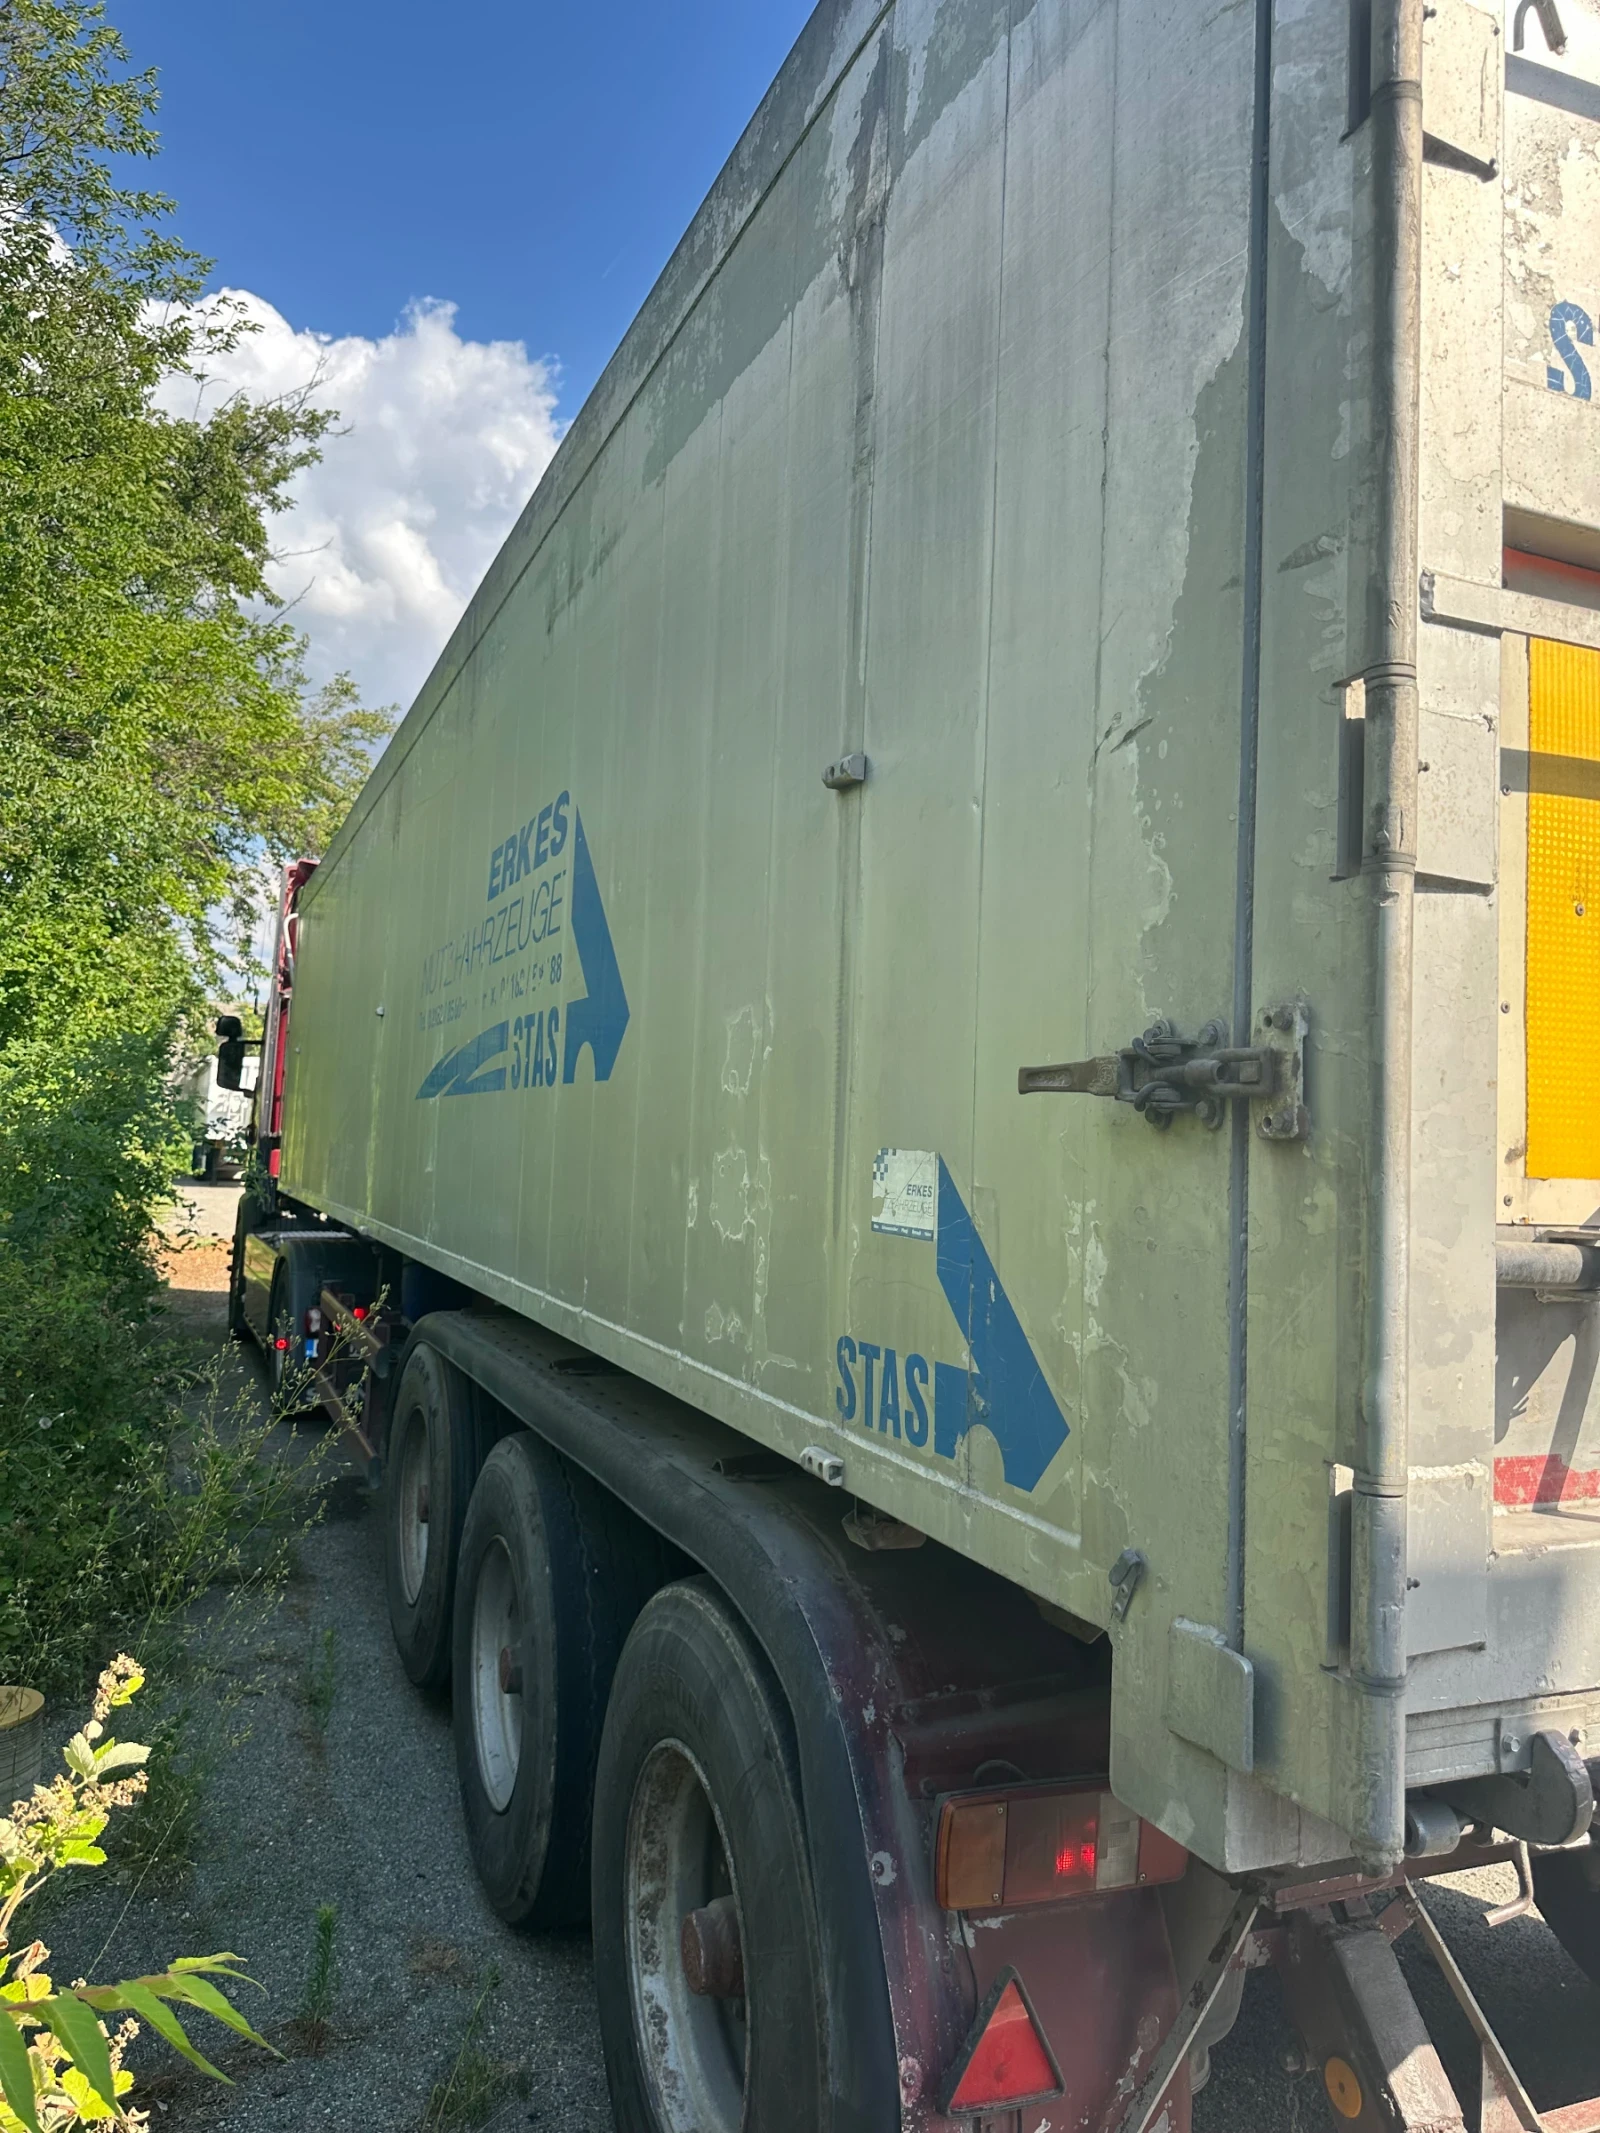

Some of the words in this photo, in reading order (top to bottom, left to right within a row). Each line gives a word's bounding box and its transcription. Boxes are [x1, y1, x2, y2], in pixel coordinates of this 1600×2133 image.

[487, 789, 570, 901] ERKES
[511, 1006, 559, 1090] STAS
[906, 1184, 933, 1198] ERKES
[836, 1335, 929, 1448] STAS
